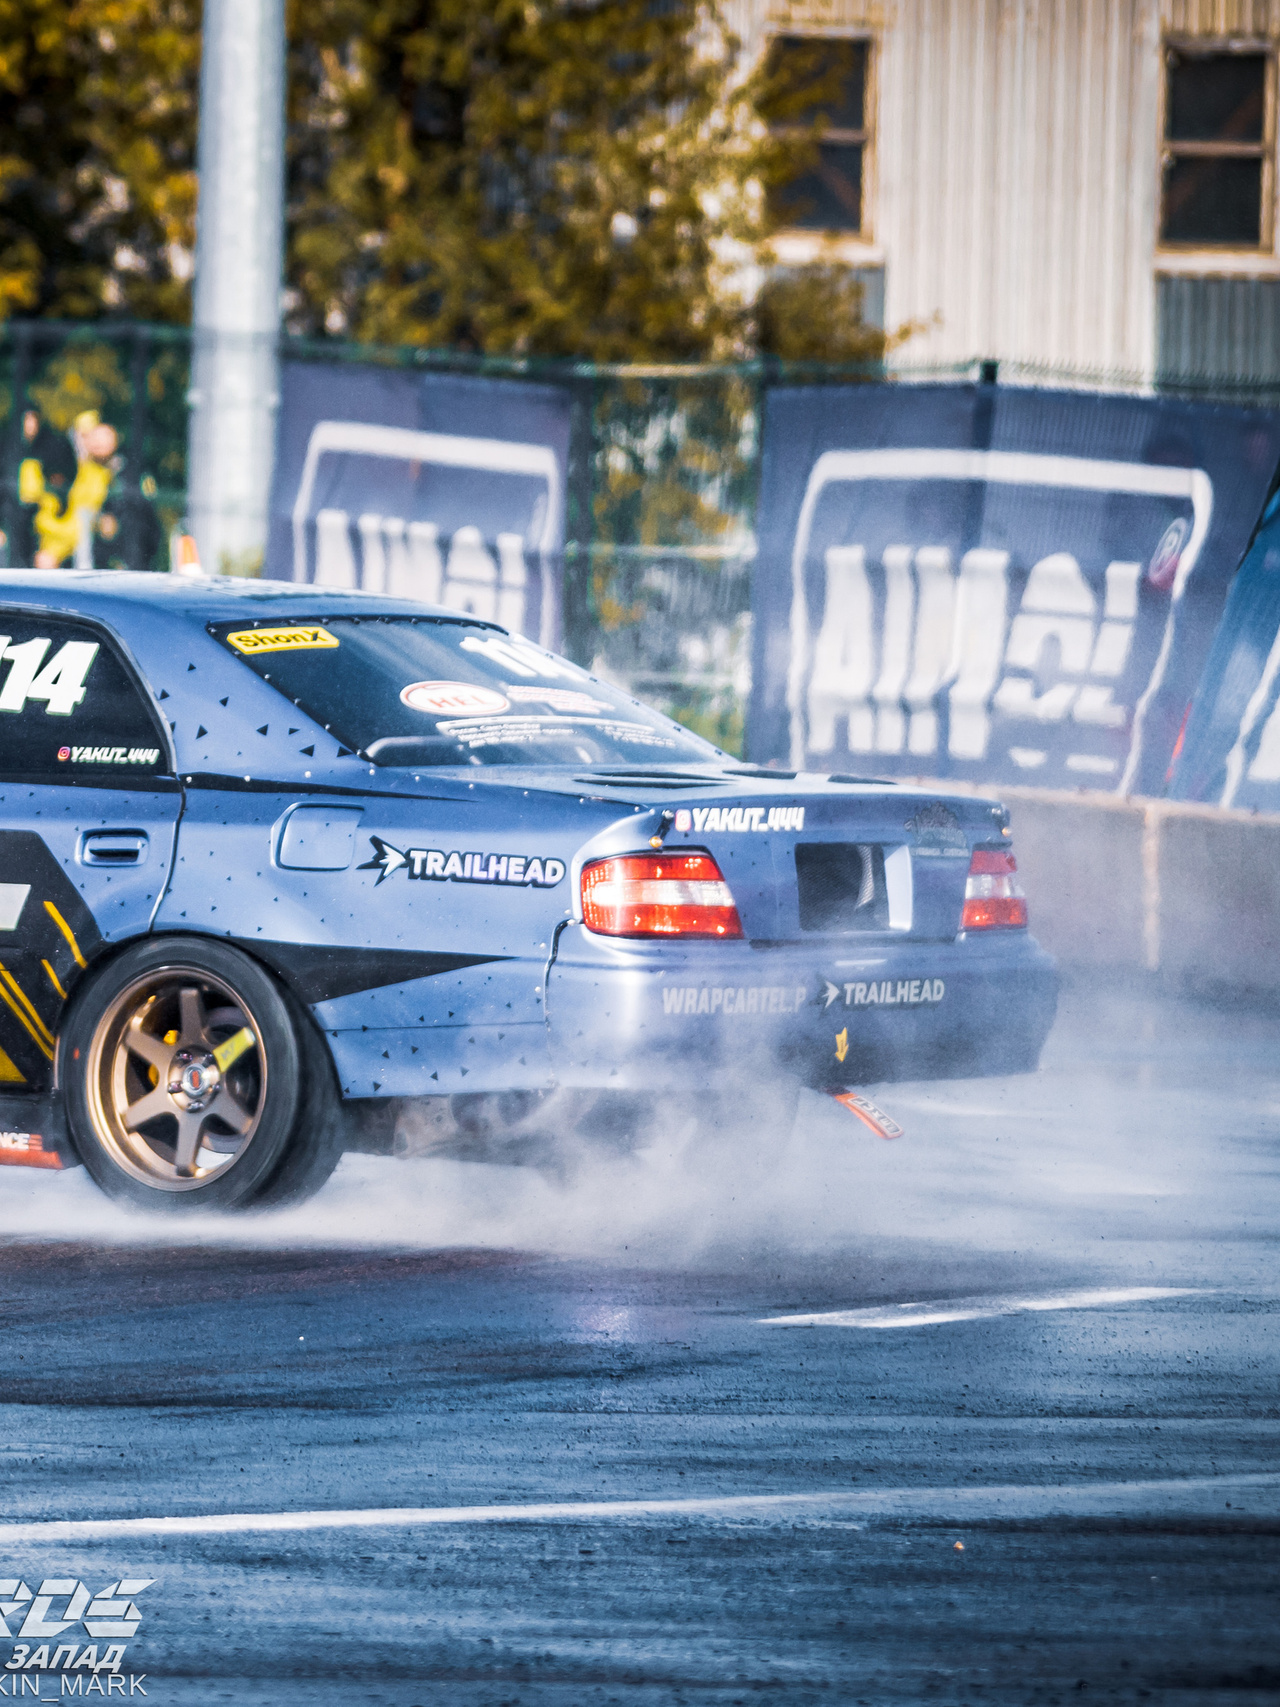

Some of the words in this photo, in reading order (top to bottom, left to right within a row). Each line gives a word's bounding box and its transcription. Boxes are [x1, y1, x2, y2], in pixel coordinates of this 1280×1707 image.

[235, 630, 328, 648] ShonX
[409, 849, 566, 886] TRAILHEAD
[842, 978, 945, 1006] TRAILHEAD
